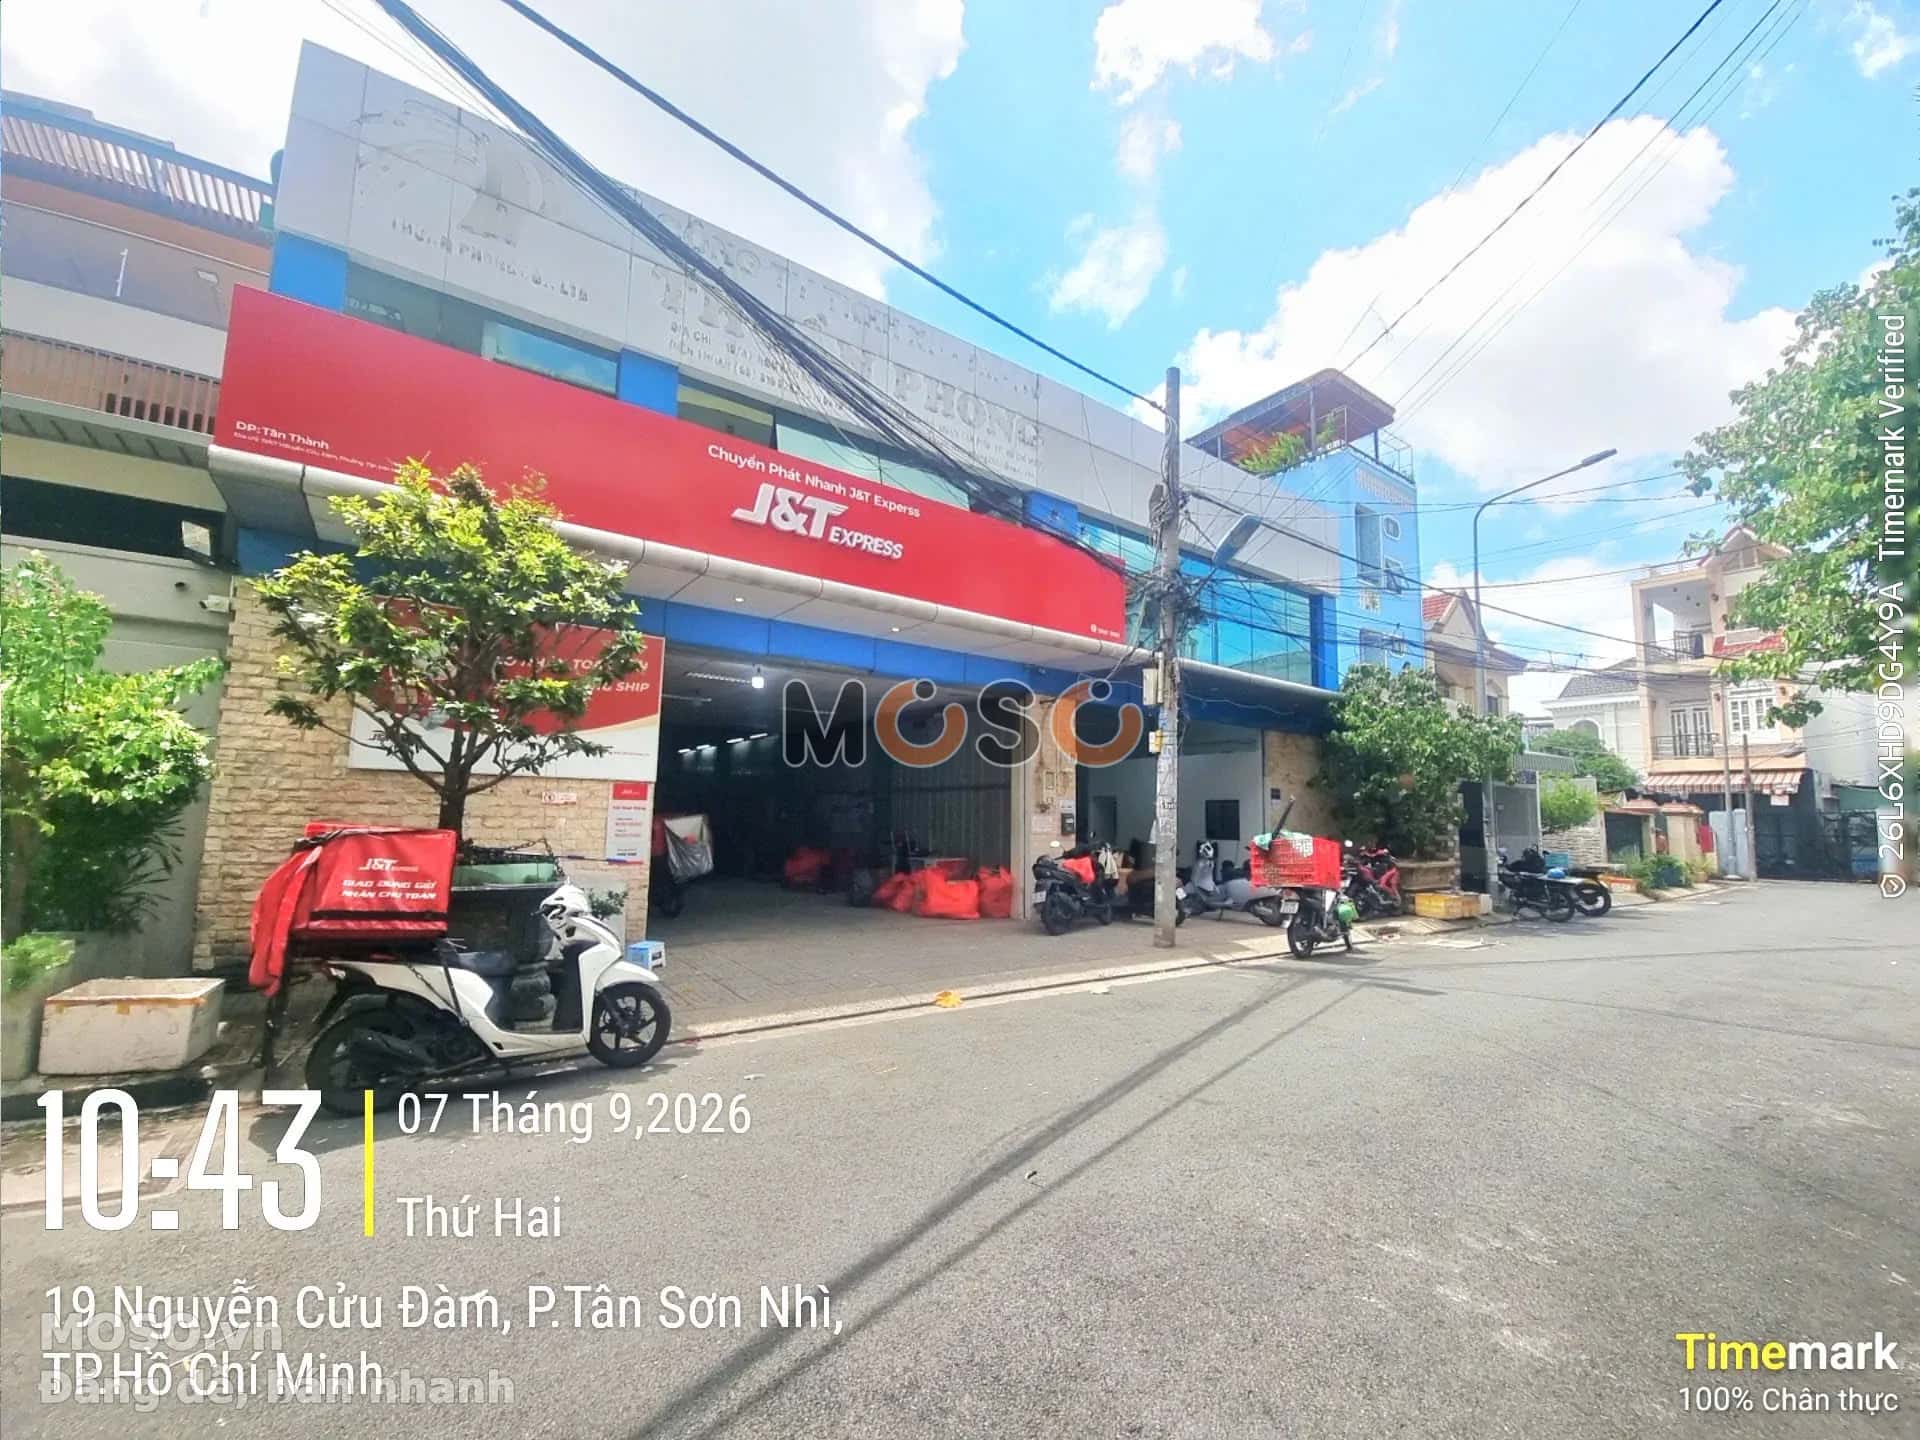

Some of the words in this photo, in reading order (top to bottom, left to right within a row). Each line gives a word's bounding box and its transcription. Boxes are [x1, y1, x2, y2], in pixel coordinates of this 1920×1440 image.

[707, 443, 766, 473] Chuyển
[768, 461, 802, 484] Phát
[804, 474, 847, 498] Nhanh
[848, 487, 873, 505] J&T
[873, 494, 921, 519] Experss
[730, 482, 849, 540] J&T
[828, 525, 904, 561] EXPRESS
[615, 681, 650, 693] SHIP
